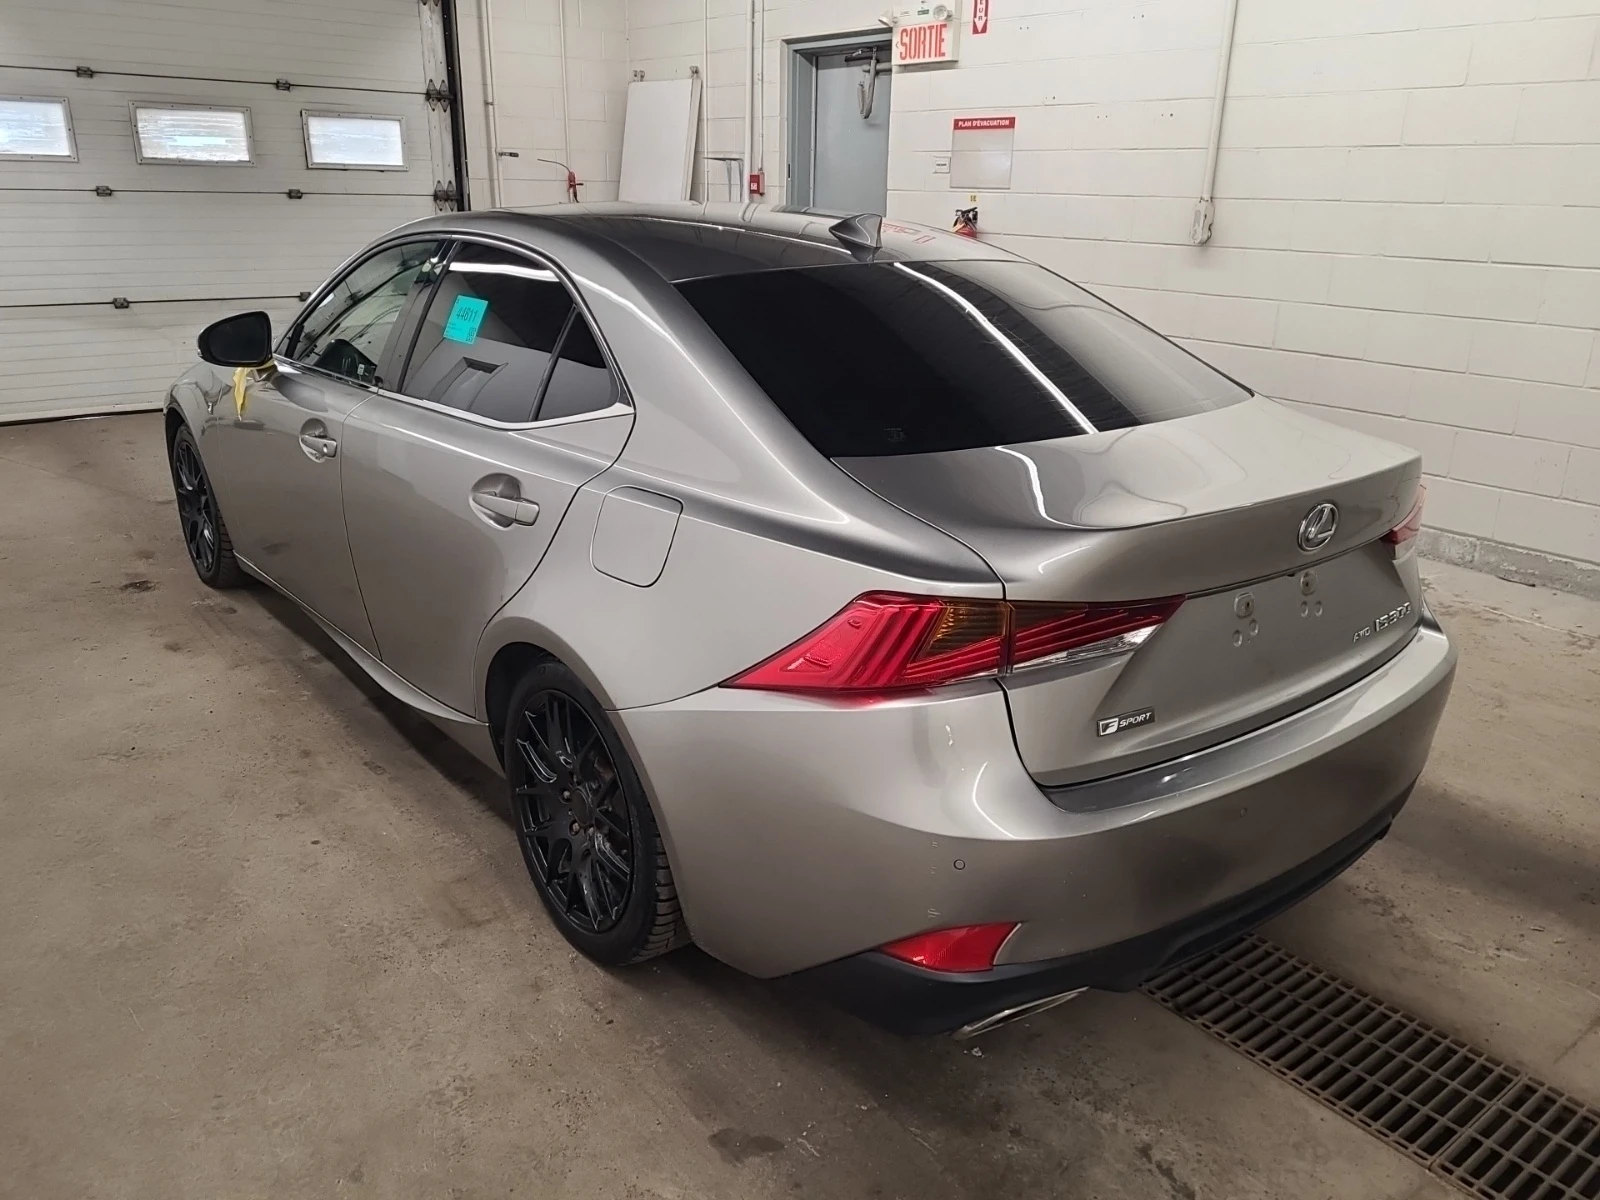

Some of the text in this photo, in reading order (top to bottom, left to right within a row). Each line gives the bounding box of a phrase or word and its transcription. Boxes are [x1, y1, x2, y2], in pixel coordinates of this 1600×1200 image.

[900, 24, 948, 60] SORTIE
[1353, 626, 1371, 642] AWD
[1119, 712, 1152, 728] SPORT
